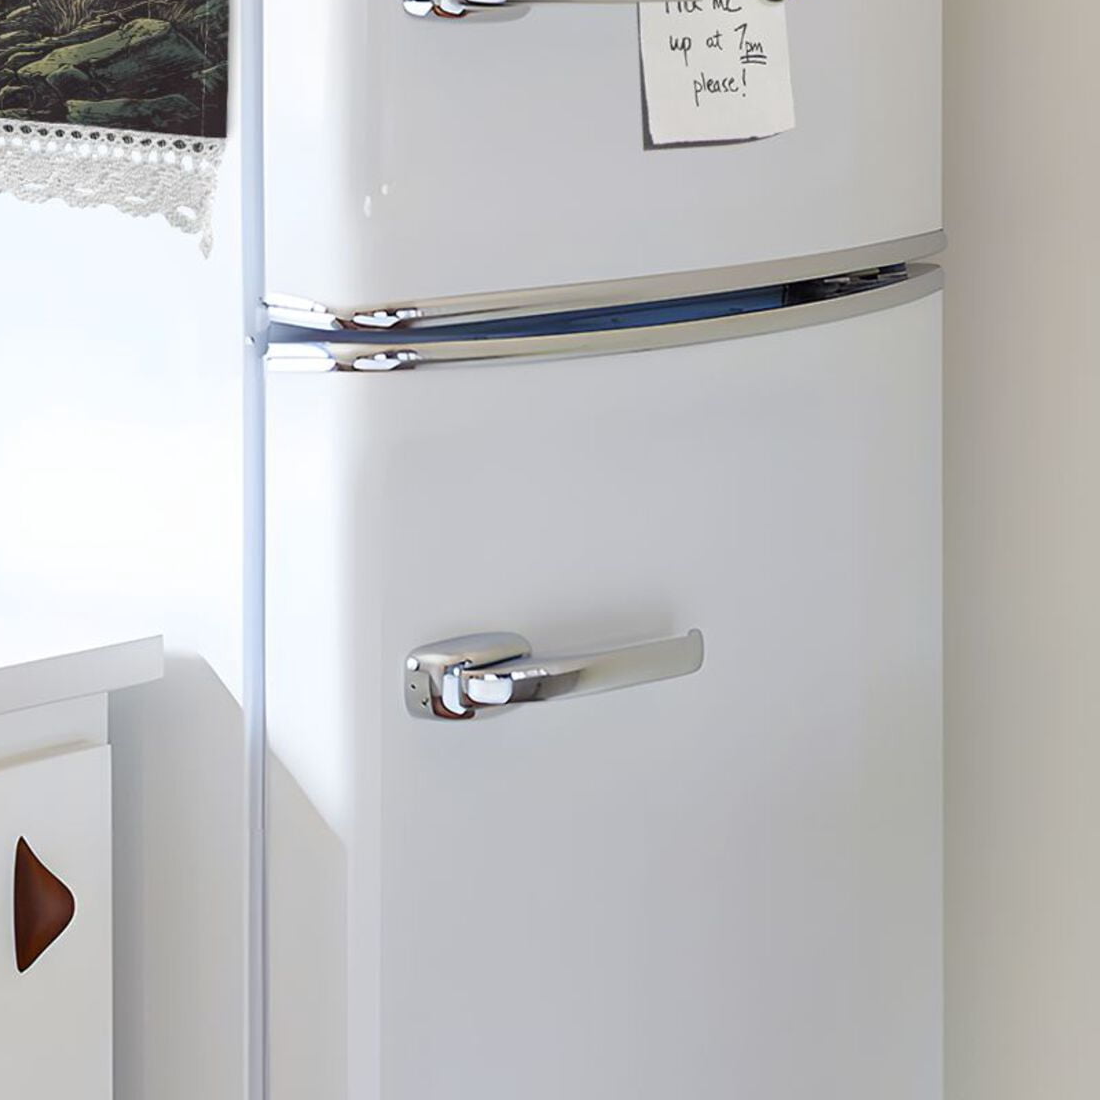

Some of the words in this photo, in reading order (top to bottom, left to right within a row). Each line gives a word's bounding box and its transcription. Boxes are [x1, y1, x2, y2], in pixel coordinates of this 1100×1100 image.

[669, 35, 692, 67] up
[706, 29, 724, 51] at
[693, 68, 747, 107] please!
